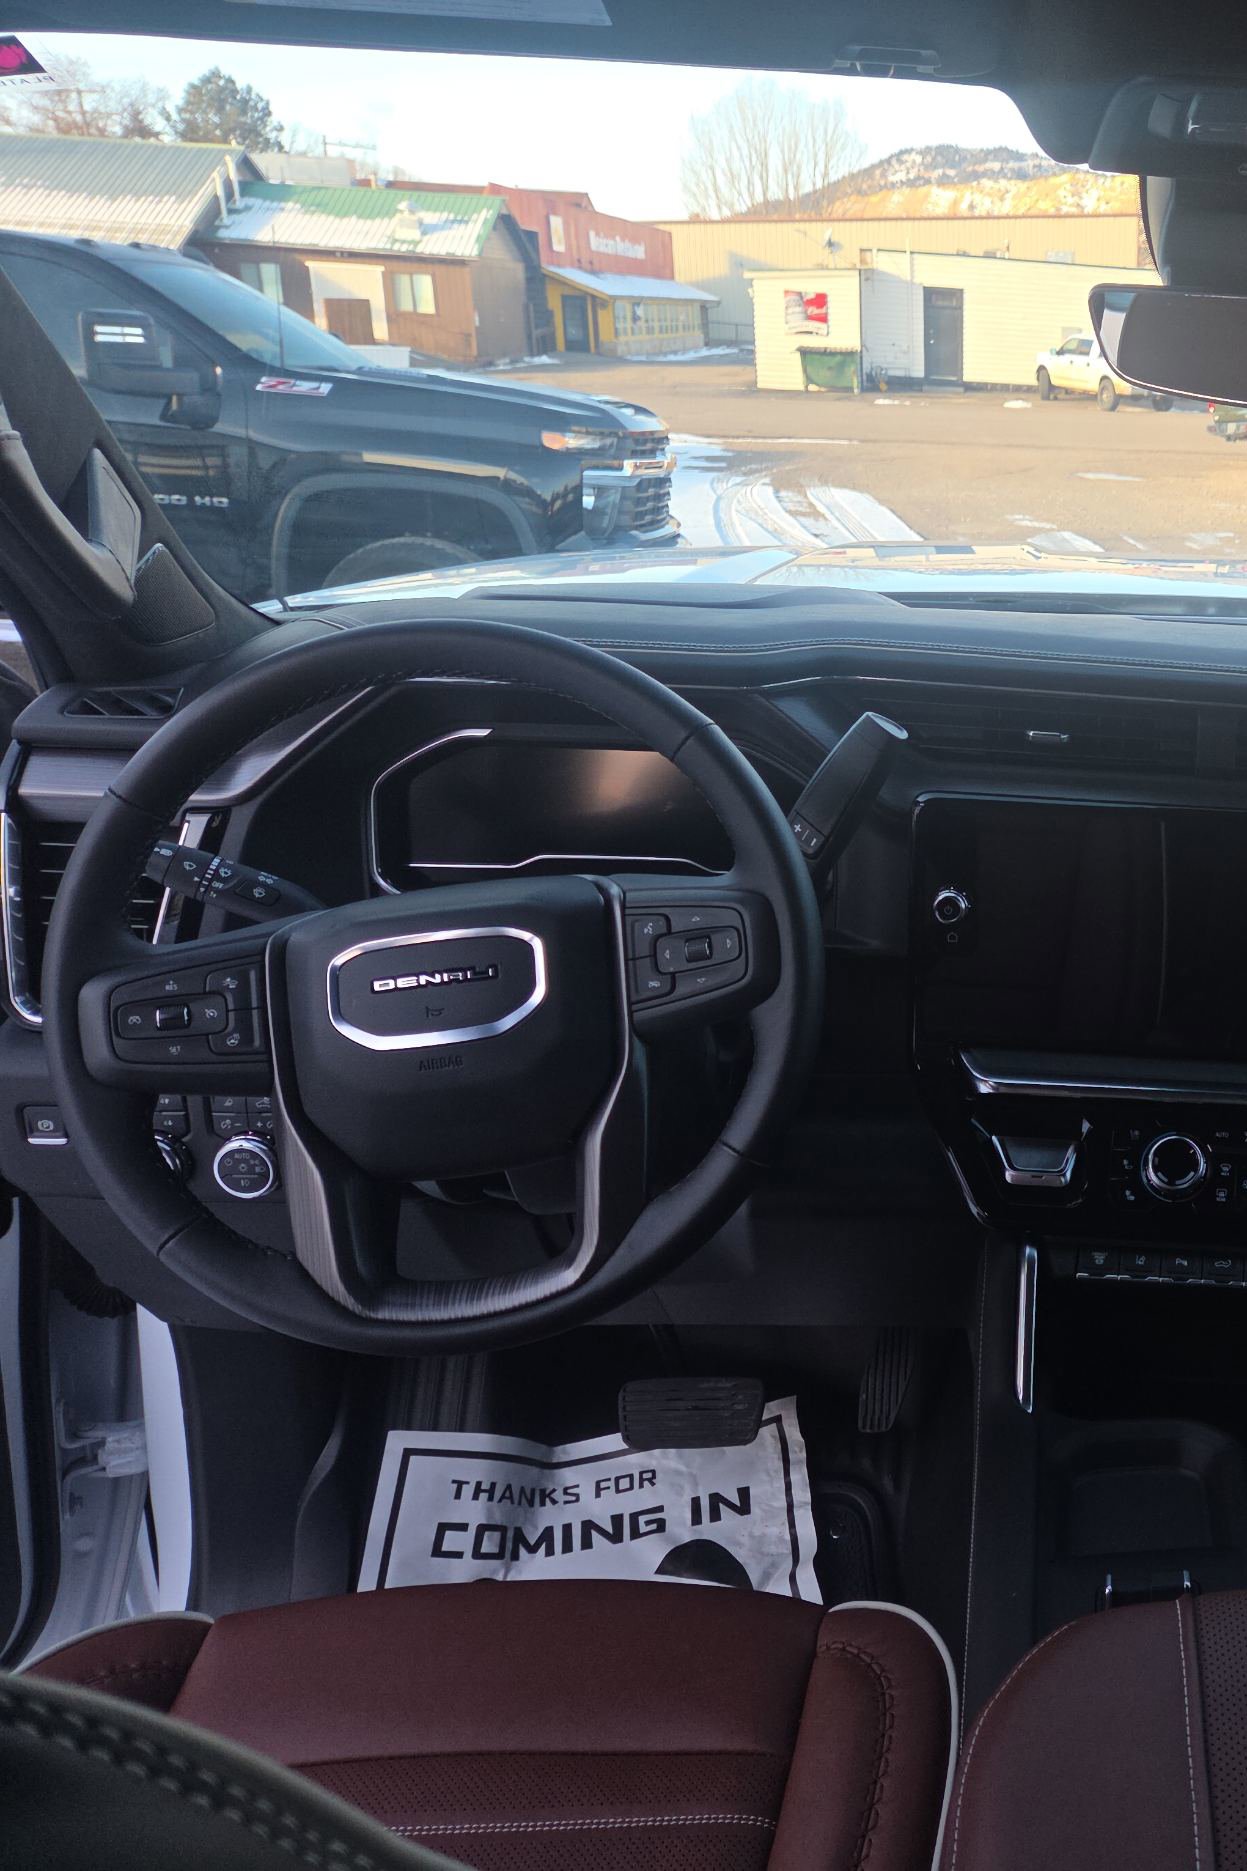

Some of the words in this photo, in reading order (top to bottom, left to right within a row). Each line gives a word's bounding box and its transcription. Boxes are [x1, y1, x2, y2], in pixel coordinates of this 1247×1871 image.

[255, 376, 334, 396] Z71
[195, 496, 230, 508] HD
[373, 966, 497, 992] DENALI
[418, 1056, 464, 1072] AIRBAG
[450, 1479, 580, 1508] THANKS
[595, 1469, 657, 1499] FOR
[430, 1505, 667, 1562] COMING
[690, 1486, 753, 1527] IN
